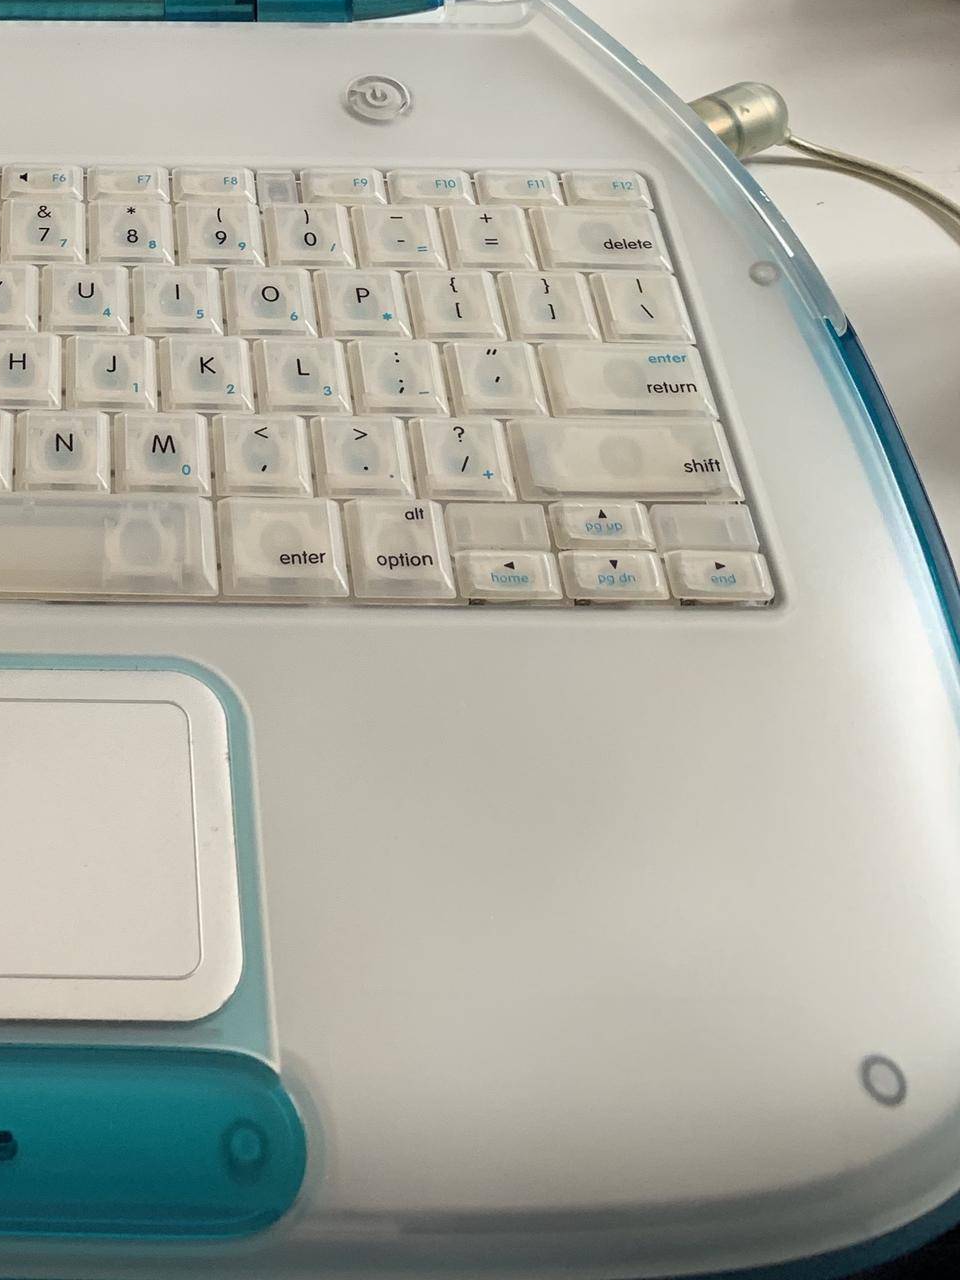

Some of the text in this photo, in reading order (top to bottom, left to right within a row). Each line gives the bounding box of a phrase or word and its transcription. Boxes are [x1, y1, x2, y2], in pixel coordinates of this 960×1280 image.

[52, 173, 66, 182] F6
[138, 175, 152, 184] F7
[224, 177, 238, 186] F8
[353, 178, 368, 187] F9
[435, 179, 457, 188] F10
[527, 179, 545, 188] F11
[612, 181, 633, 190] F12
[37, 206, 51, 218] &
[217, 208, 222, 223] (
[304, 209, 309, 224] )
[40, 228, 51, 241] 7
[126, 229, 139, 243] 8
[215, 231, 227, 245] 9
[304, 232, 317, 246] 0
[60, 238, 68, 247] 7
[148, 240, 157, 249] 8
[238, 242, 246, 250] 9
[604, 238, 652, 250] delete
[78, 282, 94, 298] U
[449, 277, 458, 293] {
[542, 279, 549, 293] }
[262, 286, 279, 302] O
[356, 288, 370, 303] P
[102, 308, 111, 317] 4
[196, 310, 204, 318] 5
[290, 312, 298, 321] 6
[456, 302, 462, 318] [
[548, 304, 555, 319] ]
[9, 353, 26, 370] H
[106, 356, 116, 372] J
[648, 353, 687, 364] enter
[200, 357, 216, 374] K
[297, 358, 309, 376] L
[133, 383, 138, 392] 1
[227, 384, 235, 394] 2
[324, 386, 332, 396] 3
[647, 381, 697, 394] return
[453, 426, 465, 442] ?
[55, 433, 73, 452] N
[152, 435, 176, 453] M
[182, 465, 190, 475] 0
[684, 459, 721, 473] shift
[404, 508, 424, 520] alt
[585, 521, 622, 533] pg up
[279, 551, 326, 565] enter
[377, 553, 433, 569] option
[490, 571, 529, 584] home
[597, 572, 635, 585] pg dn
[711, 574, 736, 585] end
